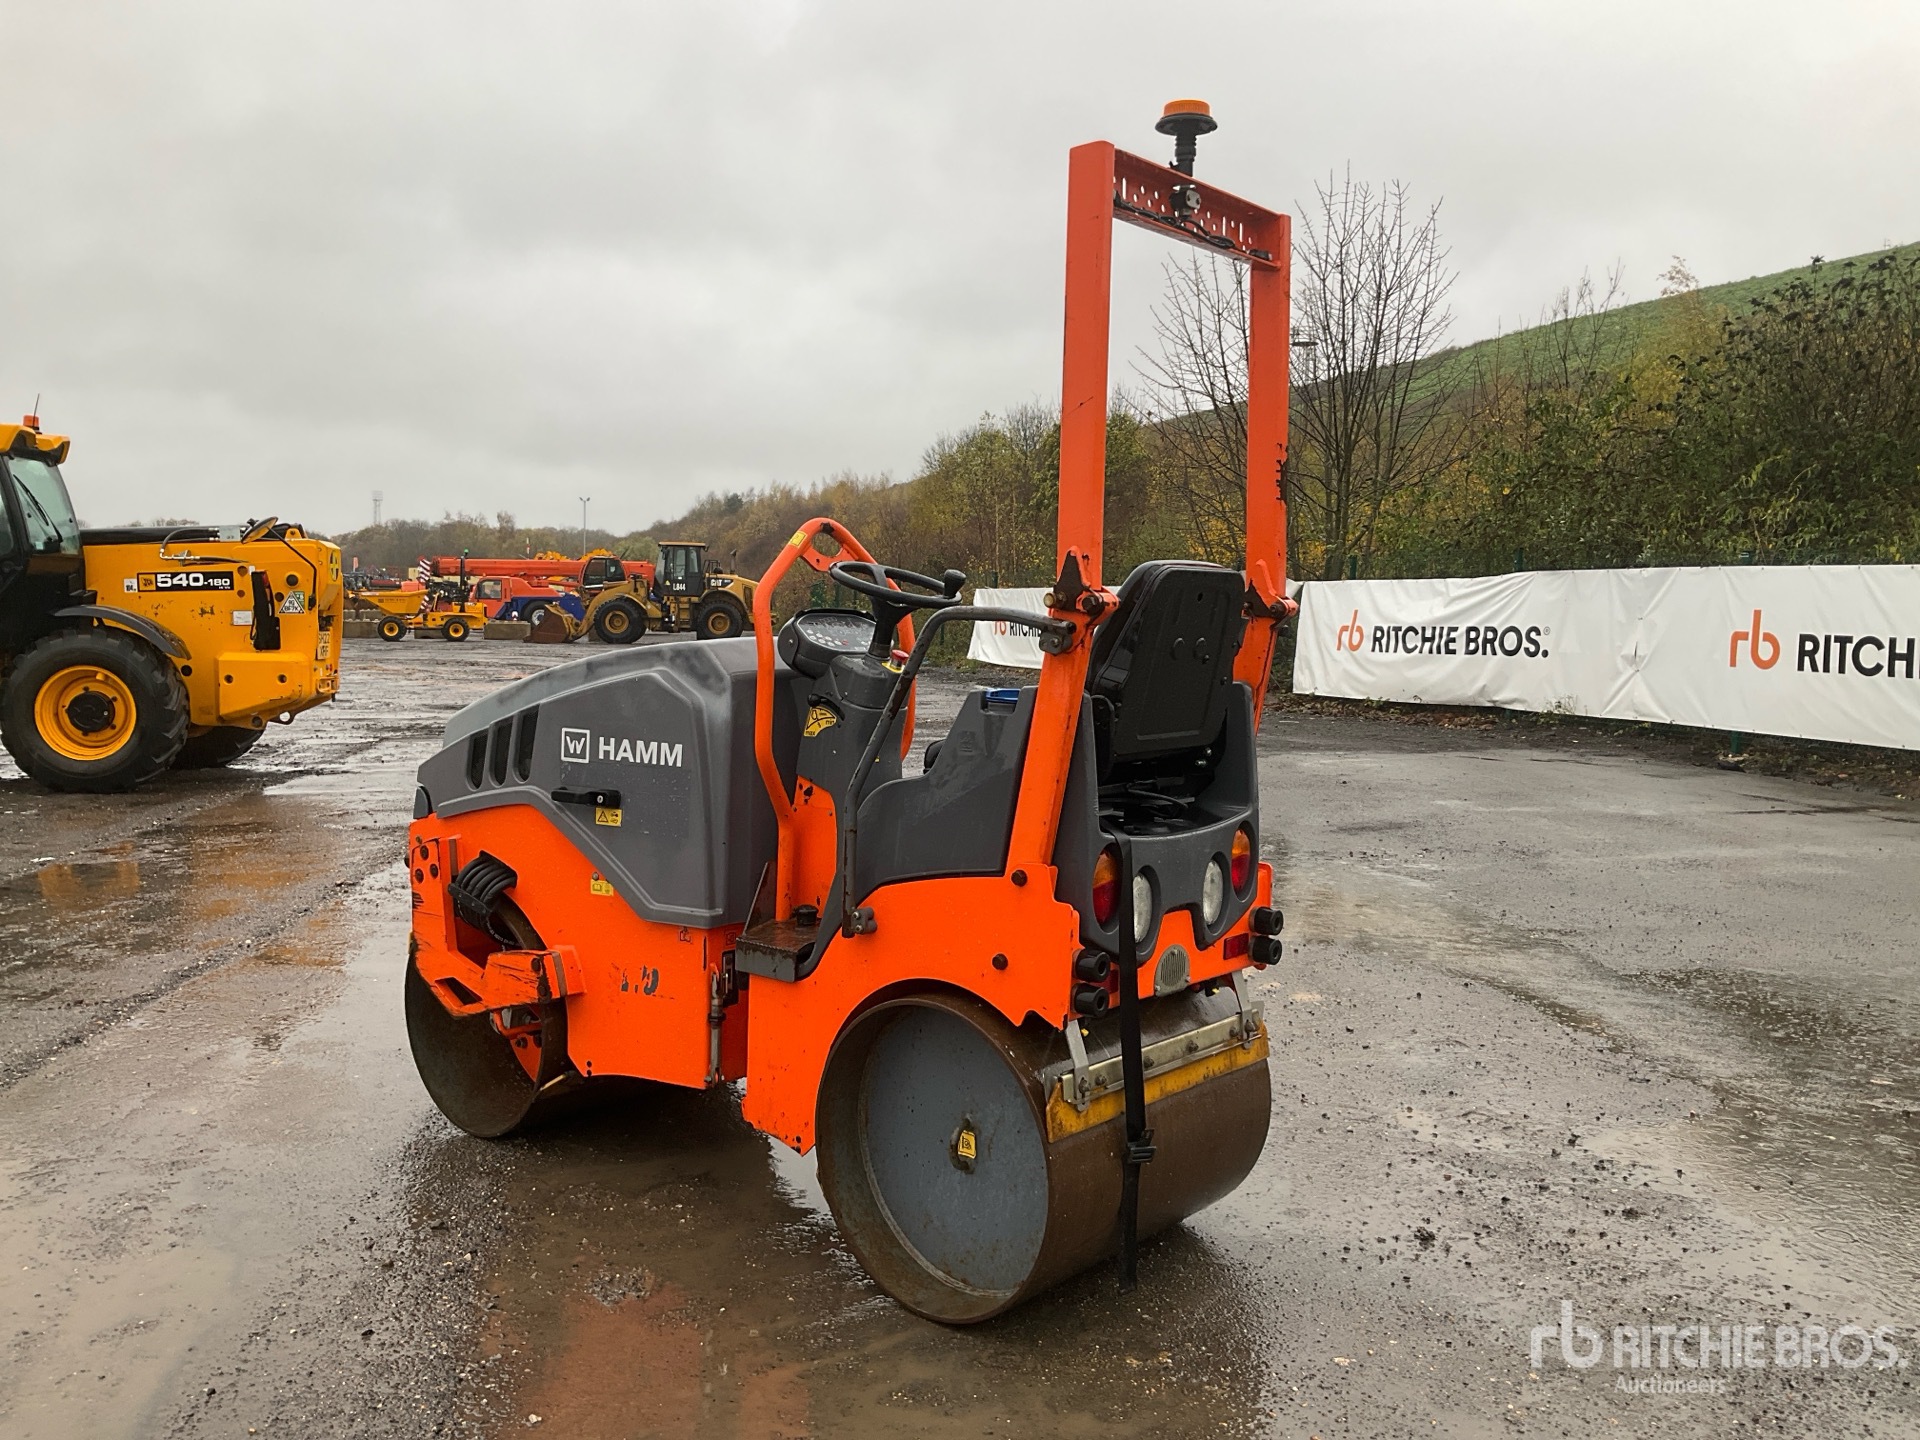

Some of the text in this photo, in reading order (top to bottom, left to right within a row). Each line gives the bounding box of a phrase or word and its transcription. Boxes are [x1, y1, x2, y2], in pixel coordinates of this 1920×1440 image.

[156, 573, 230, 587] 540-180
[1337, 609, 1549, 658] rb RITCHIE BROS.
[1729, 609, 1920, 679] rb RITCH
[598, 736, 683, 767] HAMM
